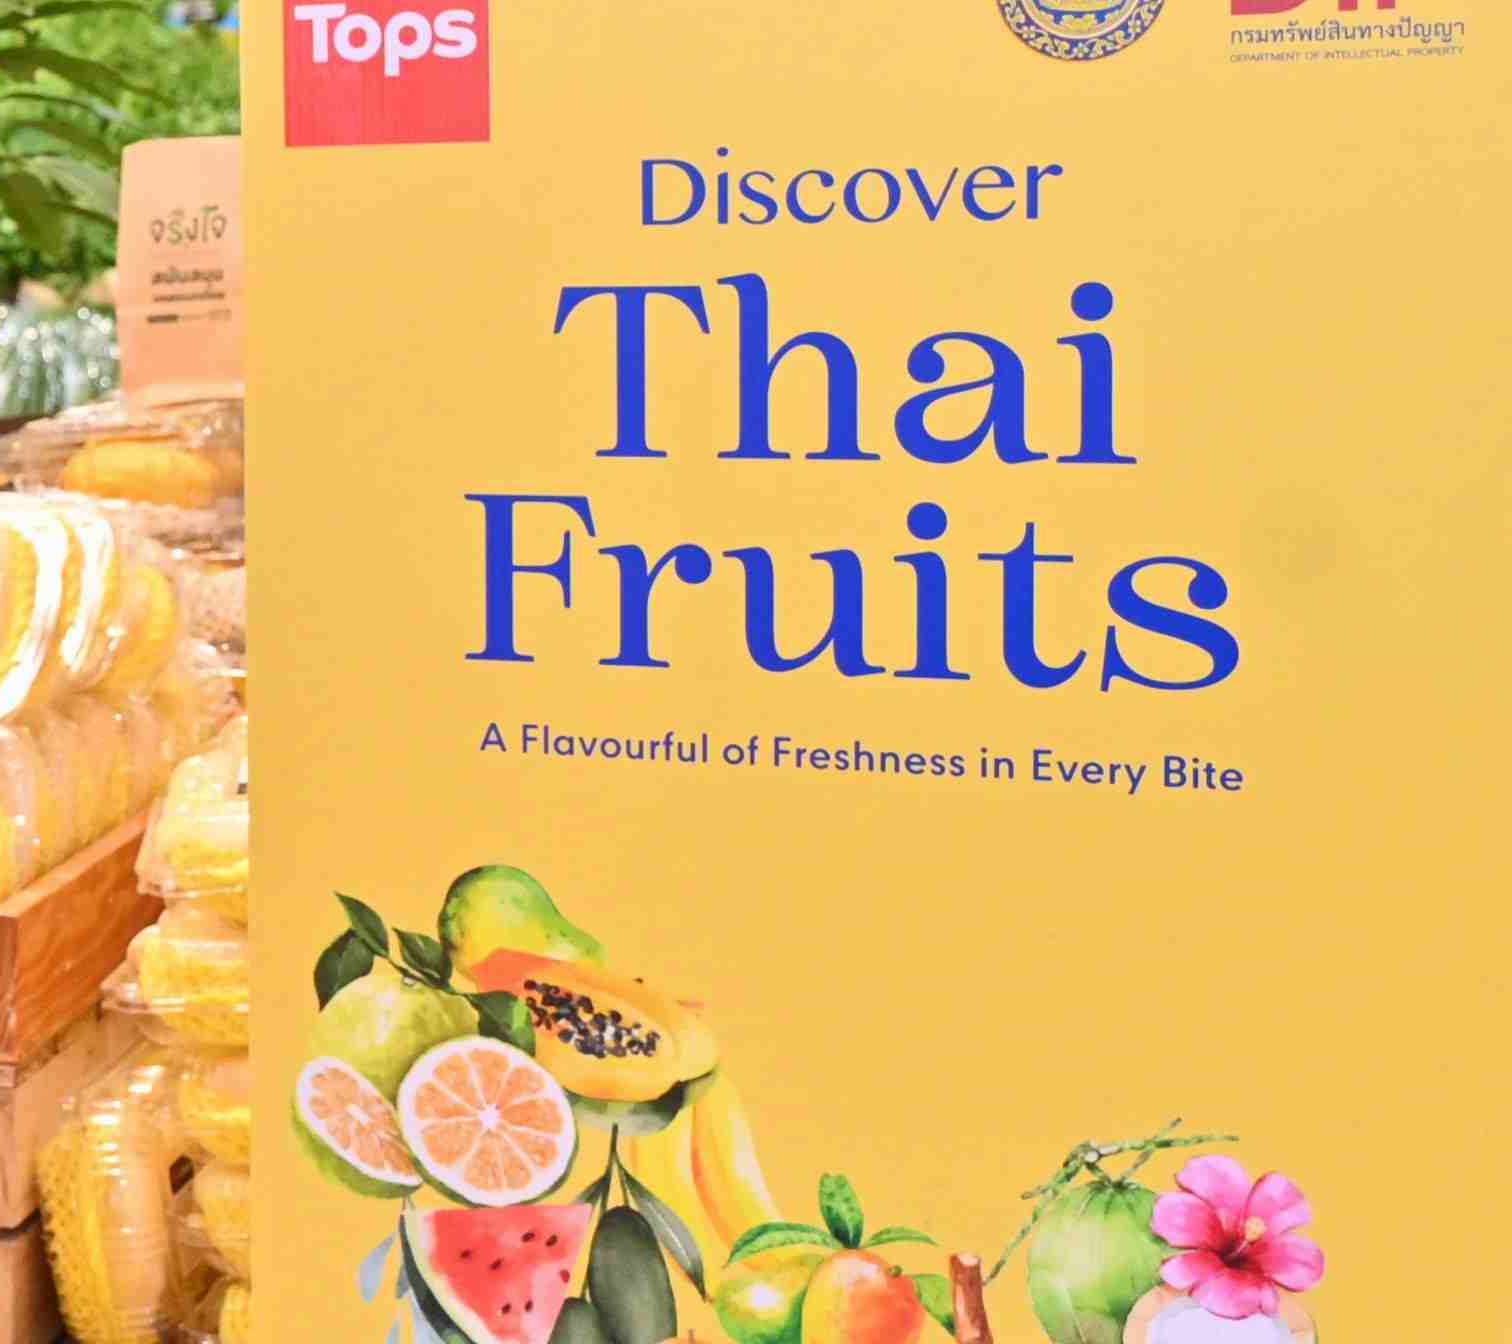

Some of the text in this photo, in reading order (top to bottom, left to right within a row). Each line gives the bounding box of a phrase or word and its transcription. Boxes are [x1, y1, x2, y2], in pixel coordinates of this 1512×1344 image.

[295, 3, 477, 77] Tops
[1230, 16, 1465, 45] กรมทรัพย์สินทางปัญญา
[642, 147, 1065, 226] Discover
[554, 272, 1138, 465] Thai
[466, 493, 1240, 691] Fruits
[480, 722, 1244, 795] A Flavourful of Freshness in Every Bite
